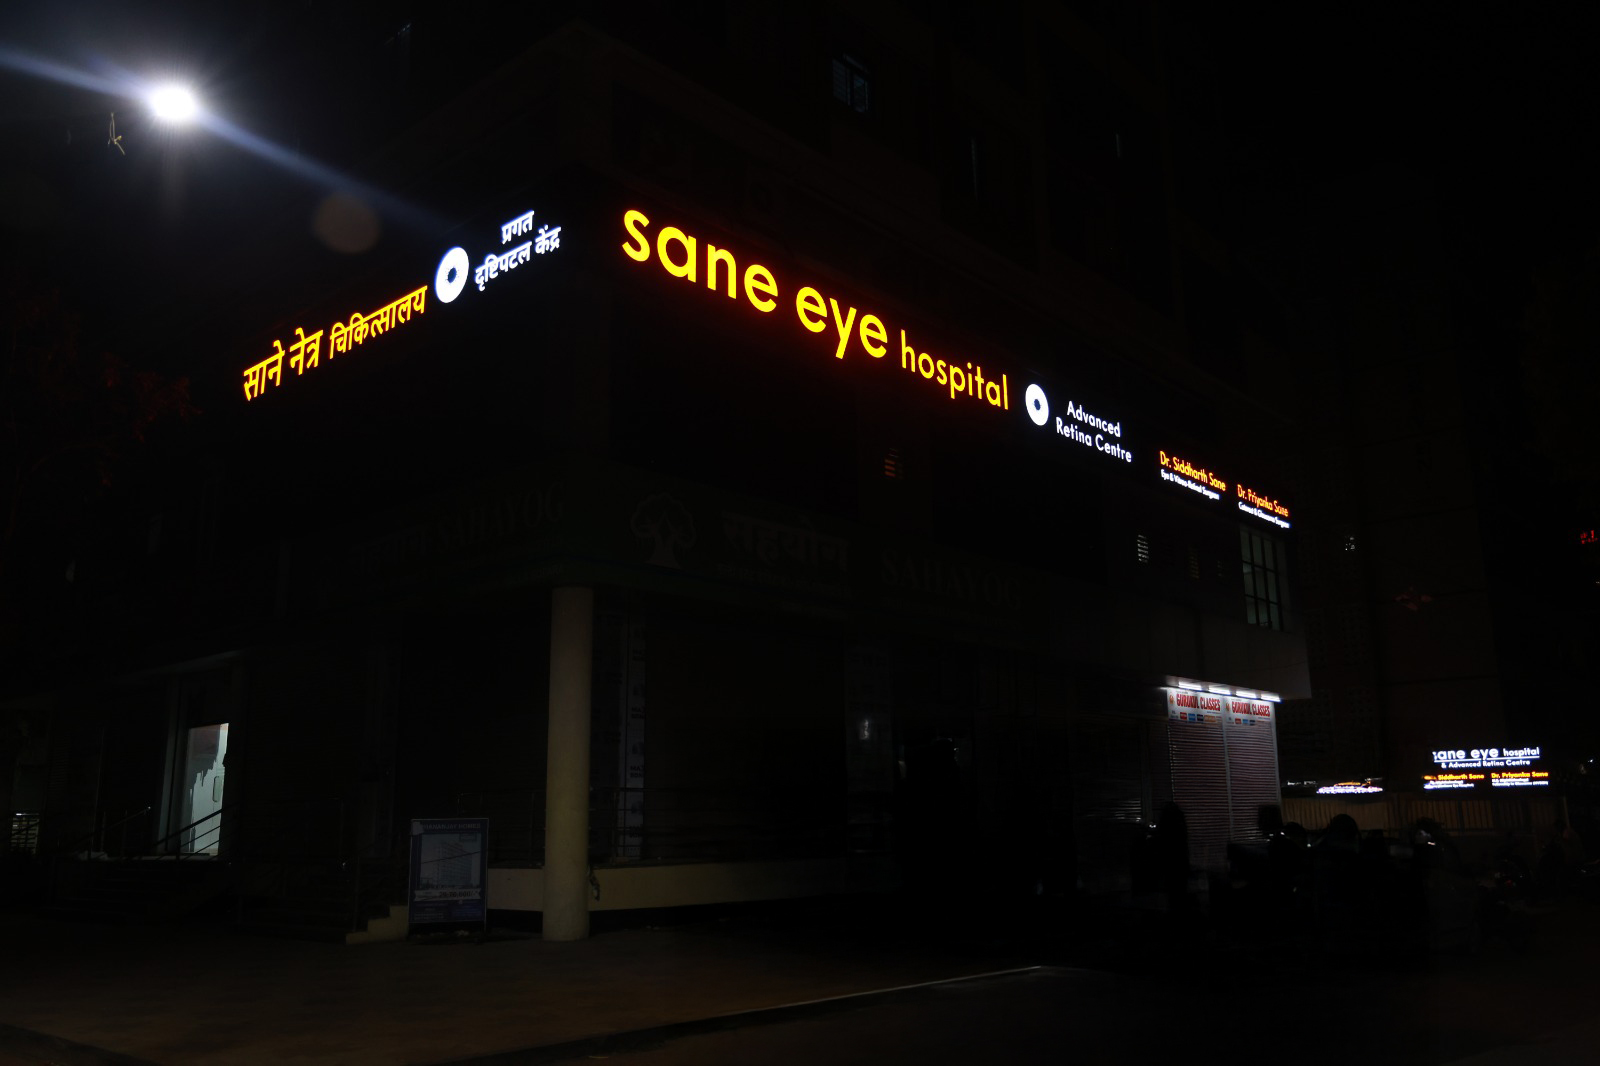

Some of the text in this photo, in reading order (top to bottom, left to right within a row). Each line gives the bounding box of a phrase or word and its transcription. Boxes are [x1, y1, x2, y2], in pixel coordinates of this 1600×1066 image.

[501, 210, 534, 244] प्रगत
[474, 224, 562, 292] दृष्टिपटल केंद्र
[622, 209, 1009, 410] sane eye hospital
[243, 285, 428, 401] साने नेत्र चिकित्सालय
[1067, 400, 1121, 437] Advanced
[1056, 416, 1132, 463] Retina Centre
[1160, 450, 1226, 492] Dr. Siddharth Sane
[1238, 484, 1288, 517] Dr. Priyanka Sane
[1200, 696, 1220, 711] CLASSES
[1252, 704, 1270, 717] CLASSES
[1470, 748, 1499, 760] eye
[1503, 747, 1540, 757] hospital
